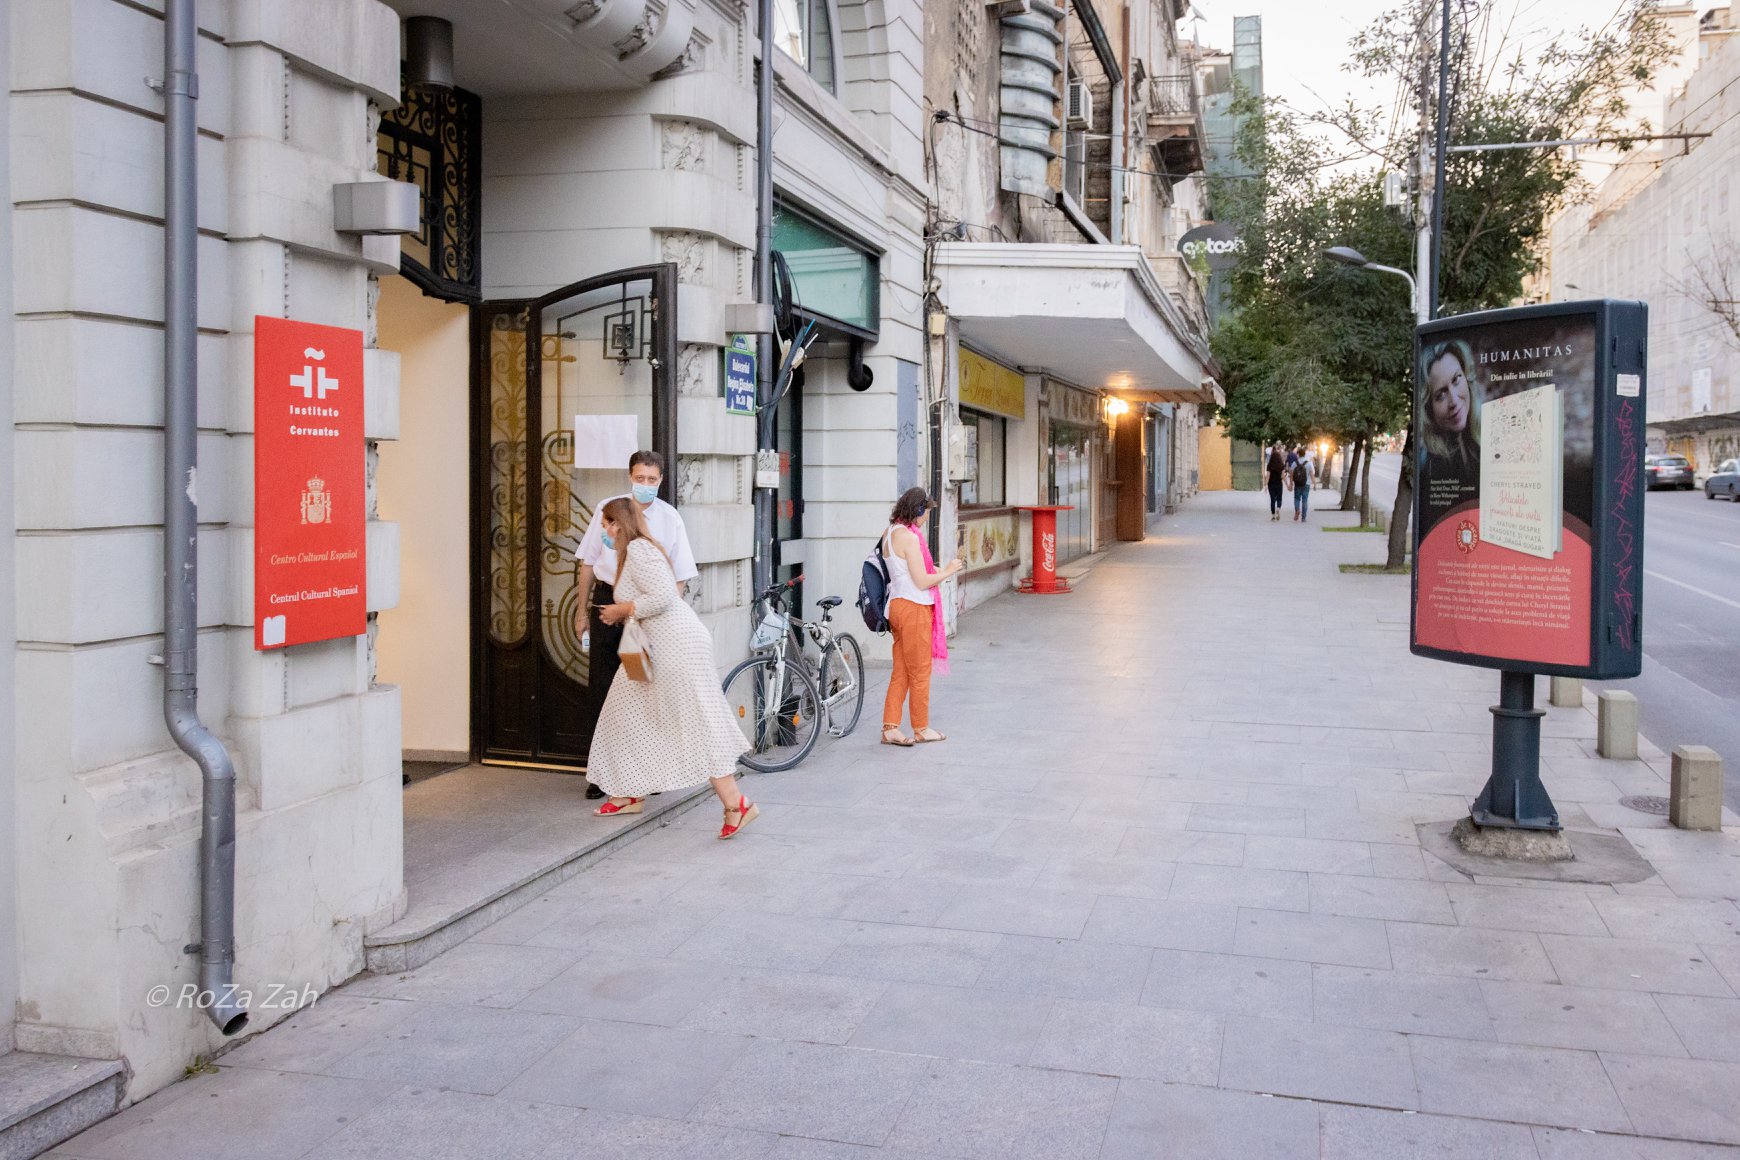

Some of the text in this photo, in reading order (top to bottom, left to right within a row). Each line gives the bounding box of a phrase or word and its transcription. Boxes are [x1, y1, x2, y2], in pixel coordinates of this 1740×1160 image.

[1480, 344, 1572, 364] HUMANITAS
[1490, 373, 1502, 382] Din
[1503, 372, 1517, 380] iulie
[1527, 369, 1554, 378] librării!
[289, 404, 340, 418] Instituto
[289, 425, 340, 437] Cervantes
[1490, 480, 1542, 490] CHERYL STRAYED
[1488, 526, 1516, 537] DRAGOSTE
[1496, 520, 1541, 535] SFATURI DESPRE
[270, 548, 358, 566] Centro Cultural Español
[1554, 565, 1572, 575] dialog
[270, 584, 359, 604] Centrul Cultural Spaniol
[1529, 601, 1549, 610] Cheryl
